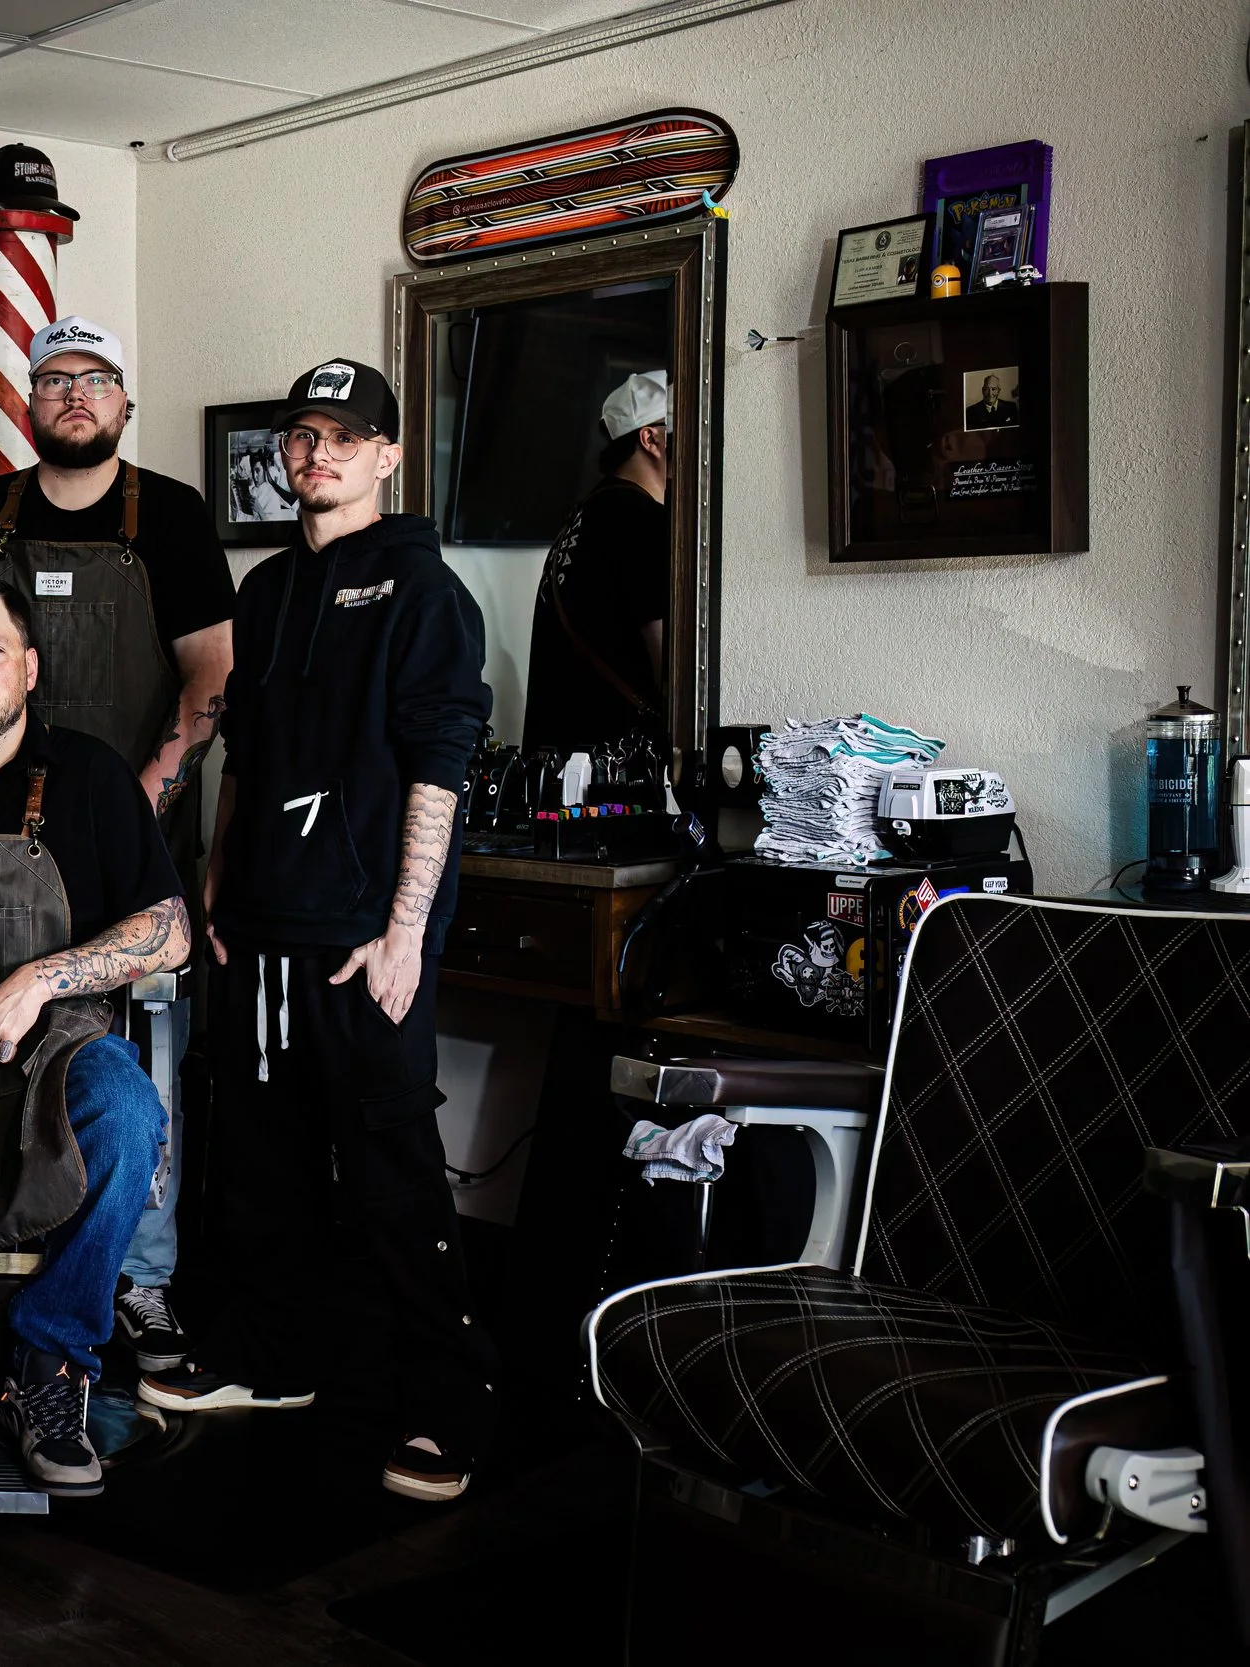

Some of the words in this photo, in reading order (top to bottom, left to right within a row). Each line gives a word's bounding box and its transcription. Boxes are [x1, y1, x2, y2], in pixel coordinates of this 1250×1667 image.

[46, 327, 67, 345] 6th
[67, 325, 105, 343] Sense
[953, 462, 984, 475] Leather
[985, 462, 1013, 472] Razor
[334, 588, 363, 606] STONE
[343, 594, 384, 608] BARBEROP
[1151, 778, 1194, 790] BICIDE
